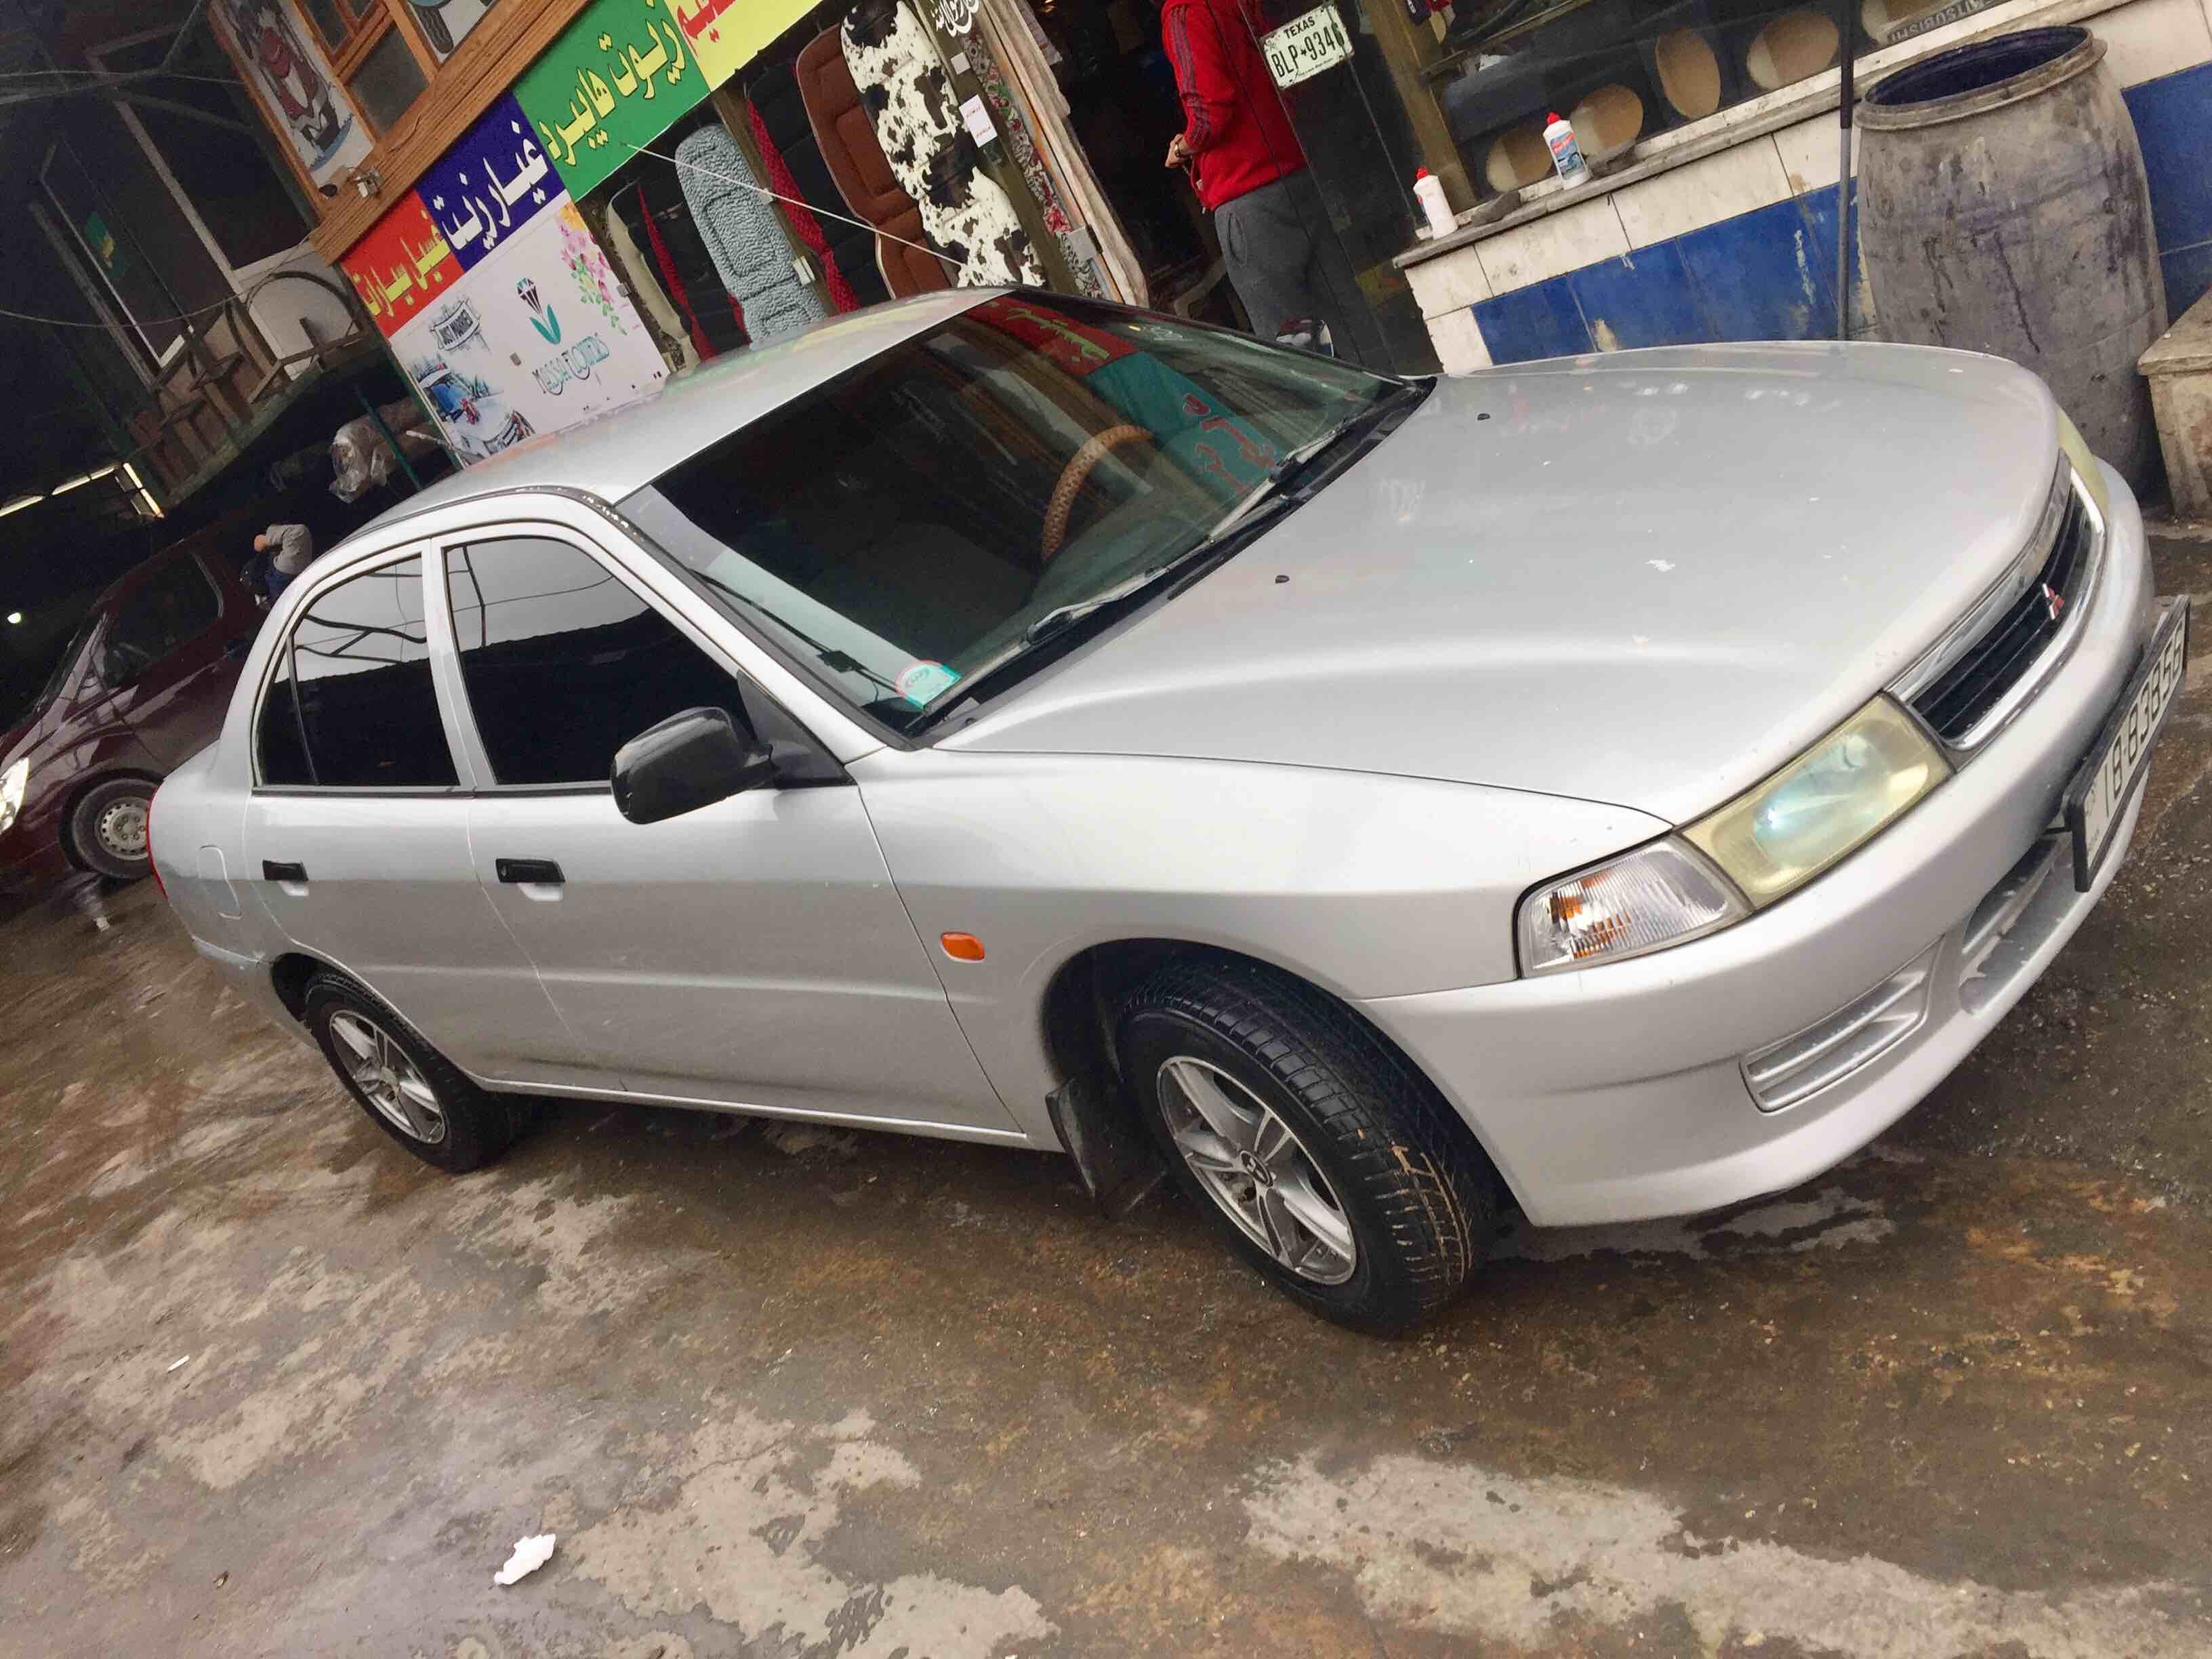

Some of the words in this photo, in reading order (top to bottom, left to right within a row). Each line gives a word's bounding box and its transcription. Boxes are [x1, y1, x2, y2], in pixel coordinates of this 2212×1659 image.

[597, 0, 686, 99] زيوت
[1283, 16, 1315, 39] TEXAS
[537, 66, 616, 166] هايبرد
[432, 171, 498, 250] زيت
[483, 119, 548, 227] غيار
[352, 262, 415, 317] سيارات
[400, 209, 451, 291] غسيل
